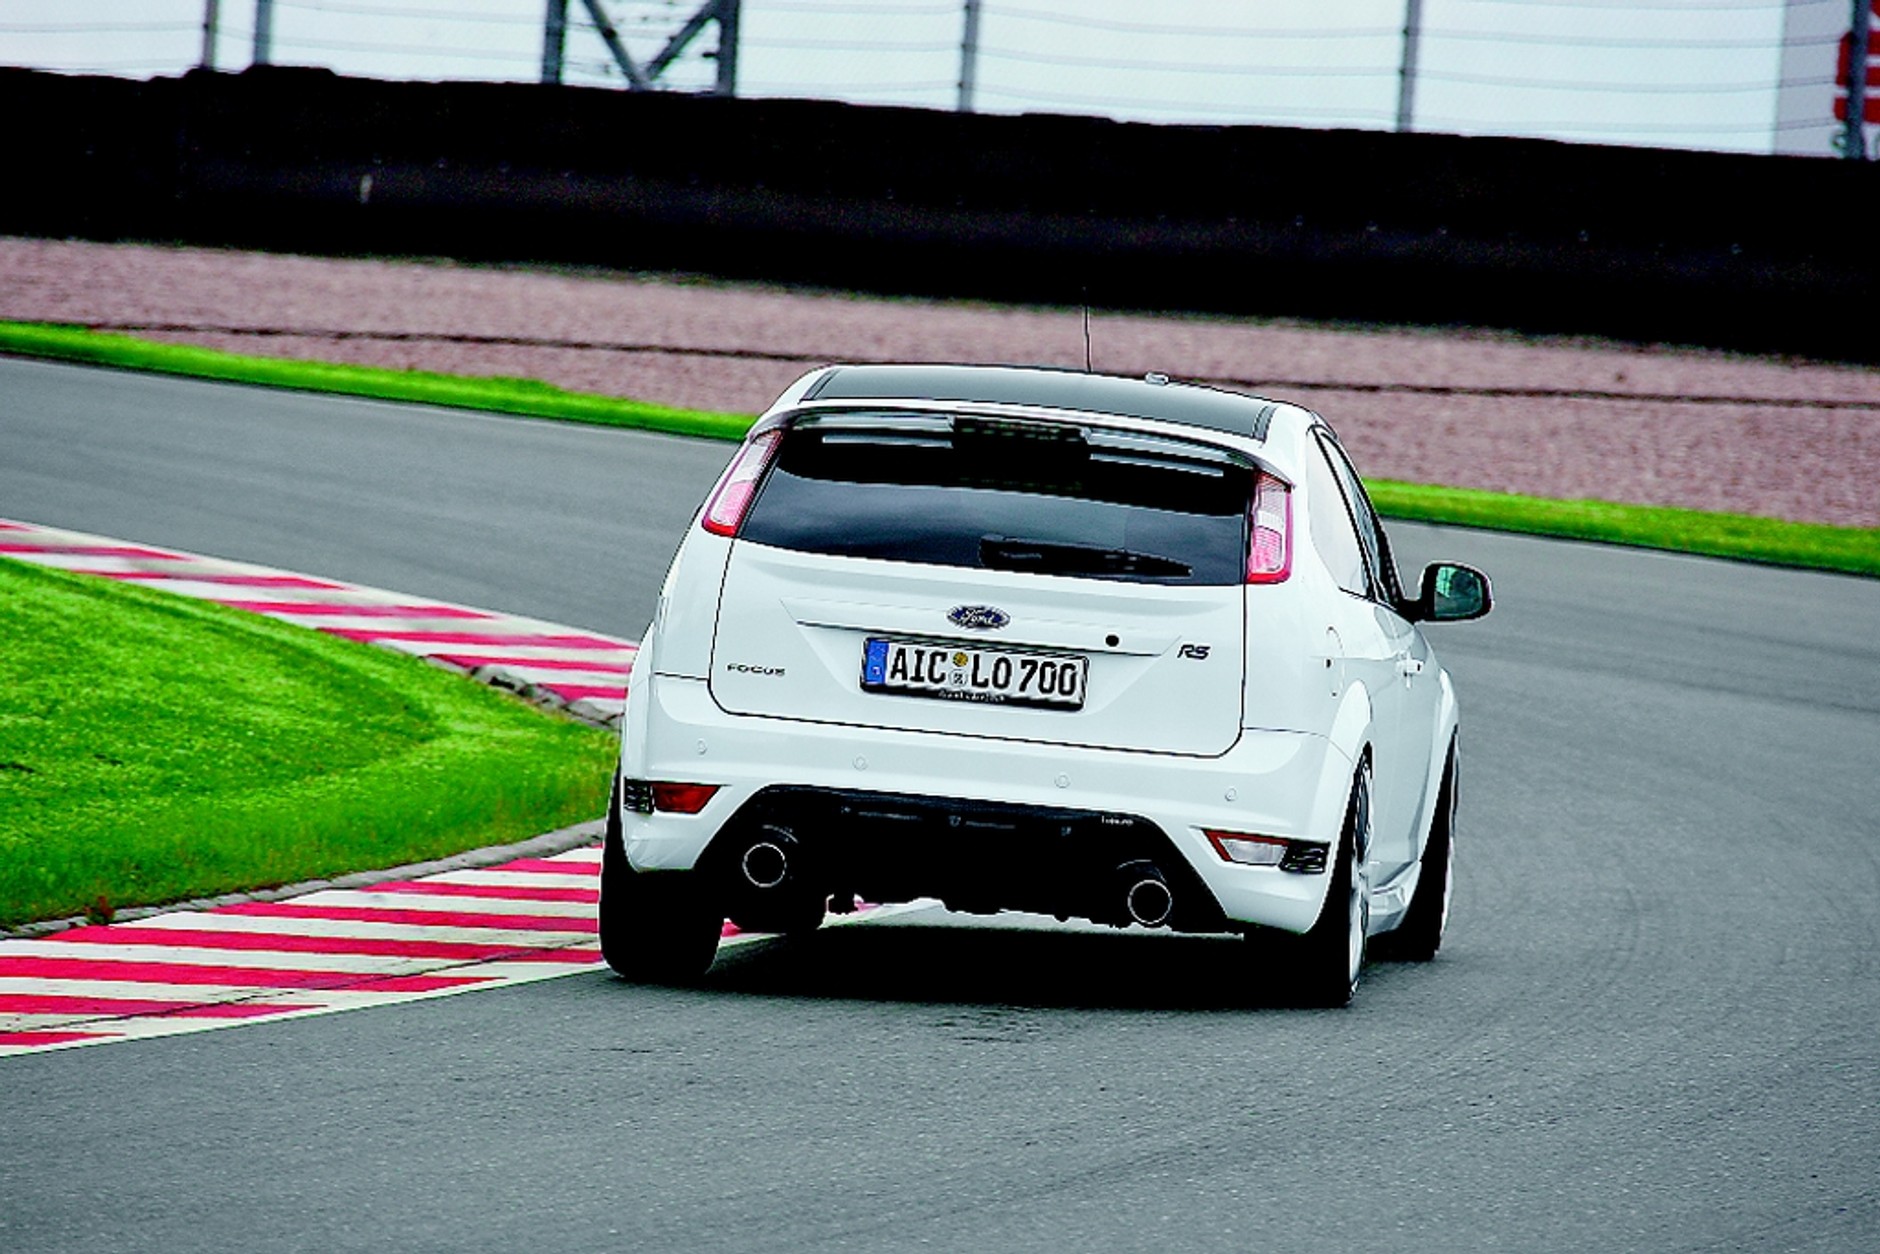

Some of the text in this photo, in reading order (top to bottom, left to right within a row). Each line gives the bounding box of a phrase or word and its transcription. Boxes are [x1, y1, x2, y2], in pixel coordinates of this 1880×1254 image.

[1177, 644, 1211, 660] RS
[727, 663, 786, 677] FOCUS
[890, 647, 1077, 697] AIC LO 700
